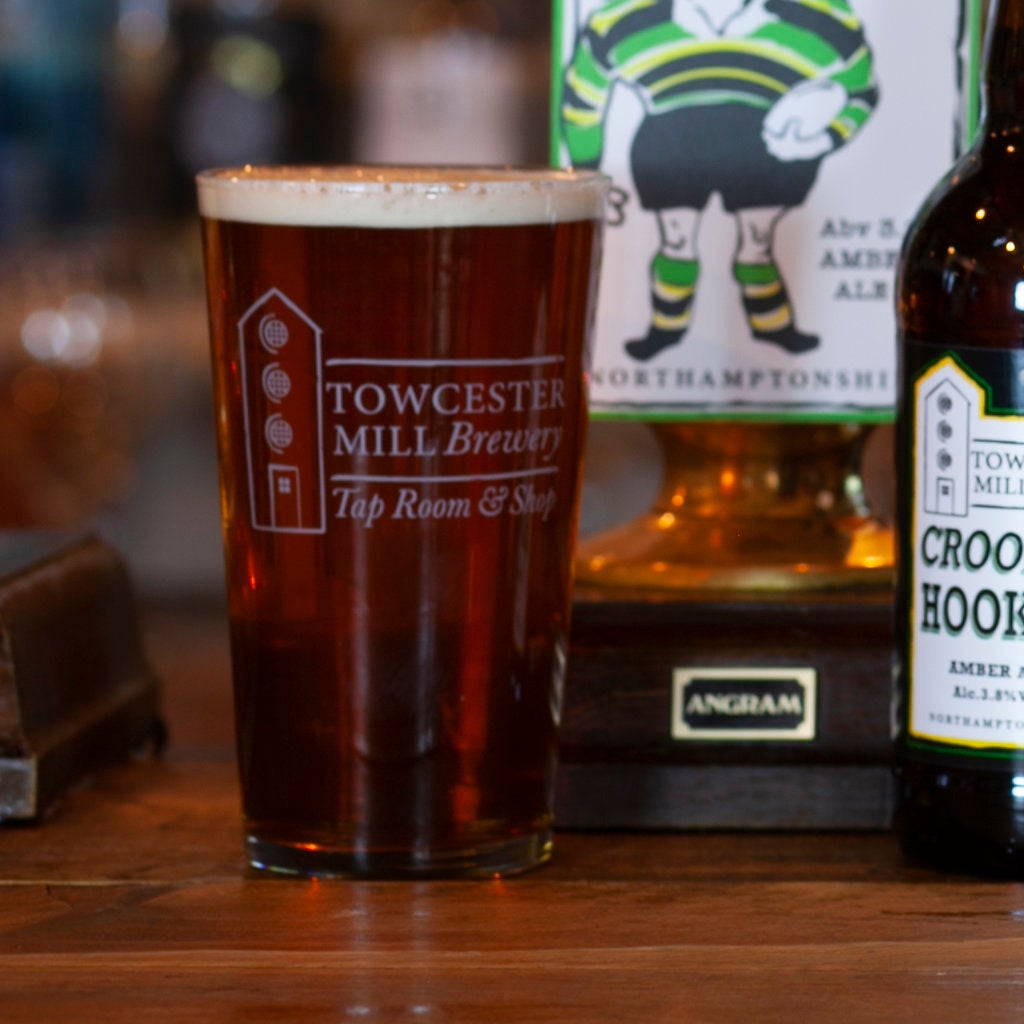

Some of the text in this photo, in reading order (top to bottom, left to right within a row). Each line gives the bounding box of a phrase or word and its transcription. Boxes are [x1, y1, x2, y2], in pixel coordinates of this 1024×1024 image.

[819, 249, 901, 270] AMBE
[834, 280, 888, 301] ALE
[589, 367, 889, 390] NORTHAMPTONSHI
[326, 378, 565, 416] TOWCESTER
[333, 421, 564, 462] MILL Brewery
[332, 485, 557, 529] Tap Room & Shop
[948, 660, 1011, 678] AMBER
[686, 693, 802, 715] ANGRAM
